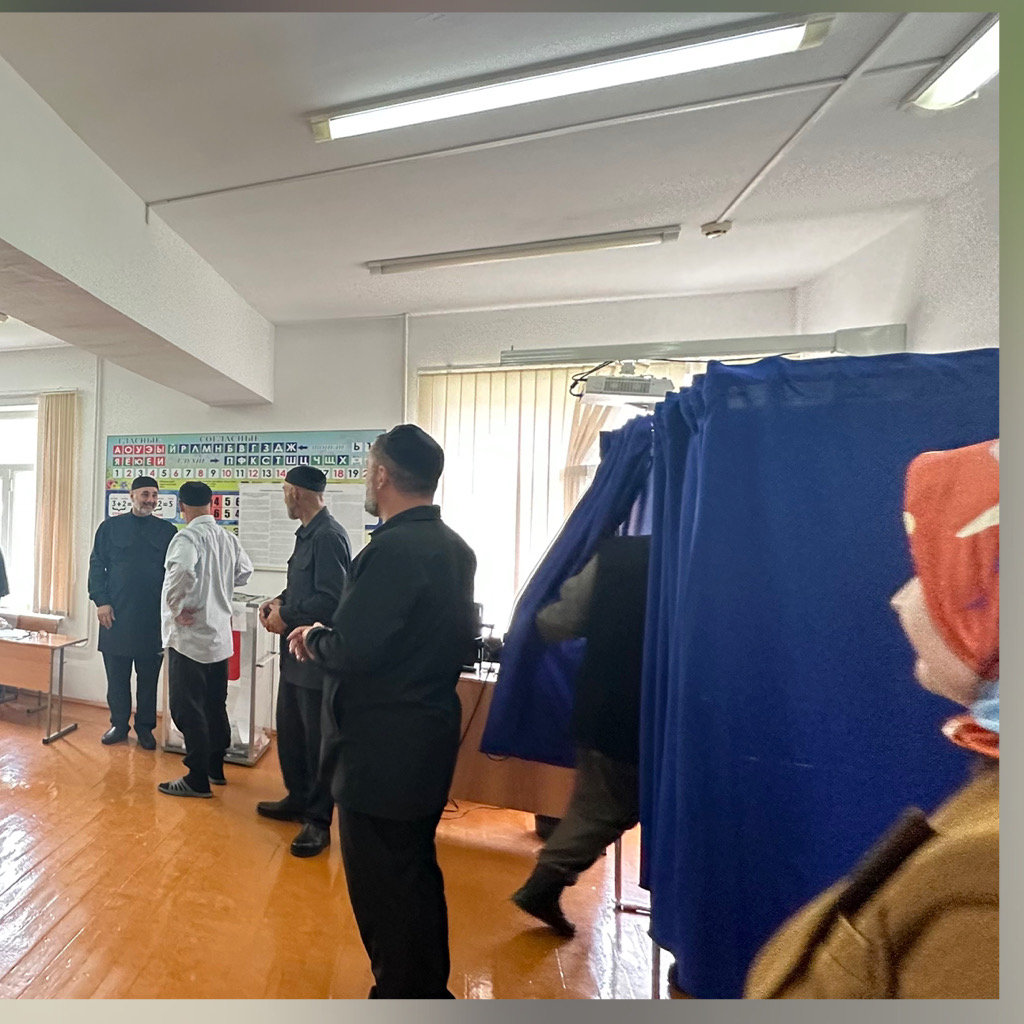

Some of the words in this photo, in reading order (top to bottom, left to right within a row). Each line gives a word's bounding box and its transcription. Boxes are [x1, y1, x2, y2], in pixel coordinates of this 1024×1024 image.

[214, 497, 219, 506] 4
[225, 497, 231, 506] 5
[225, 509, 231, 518] 5
